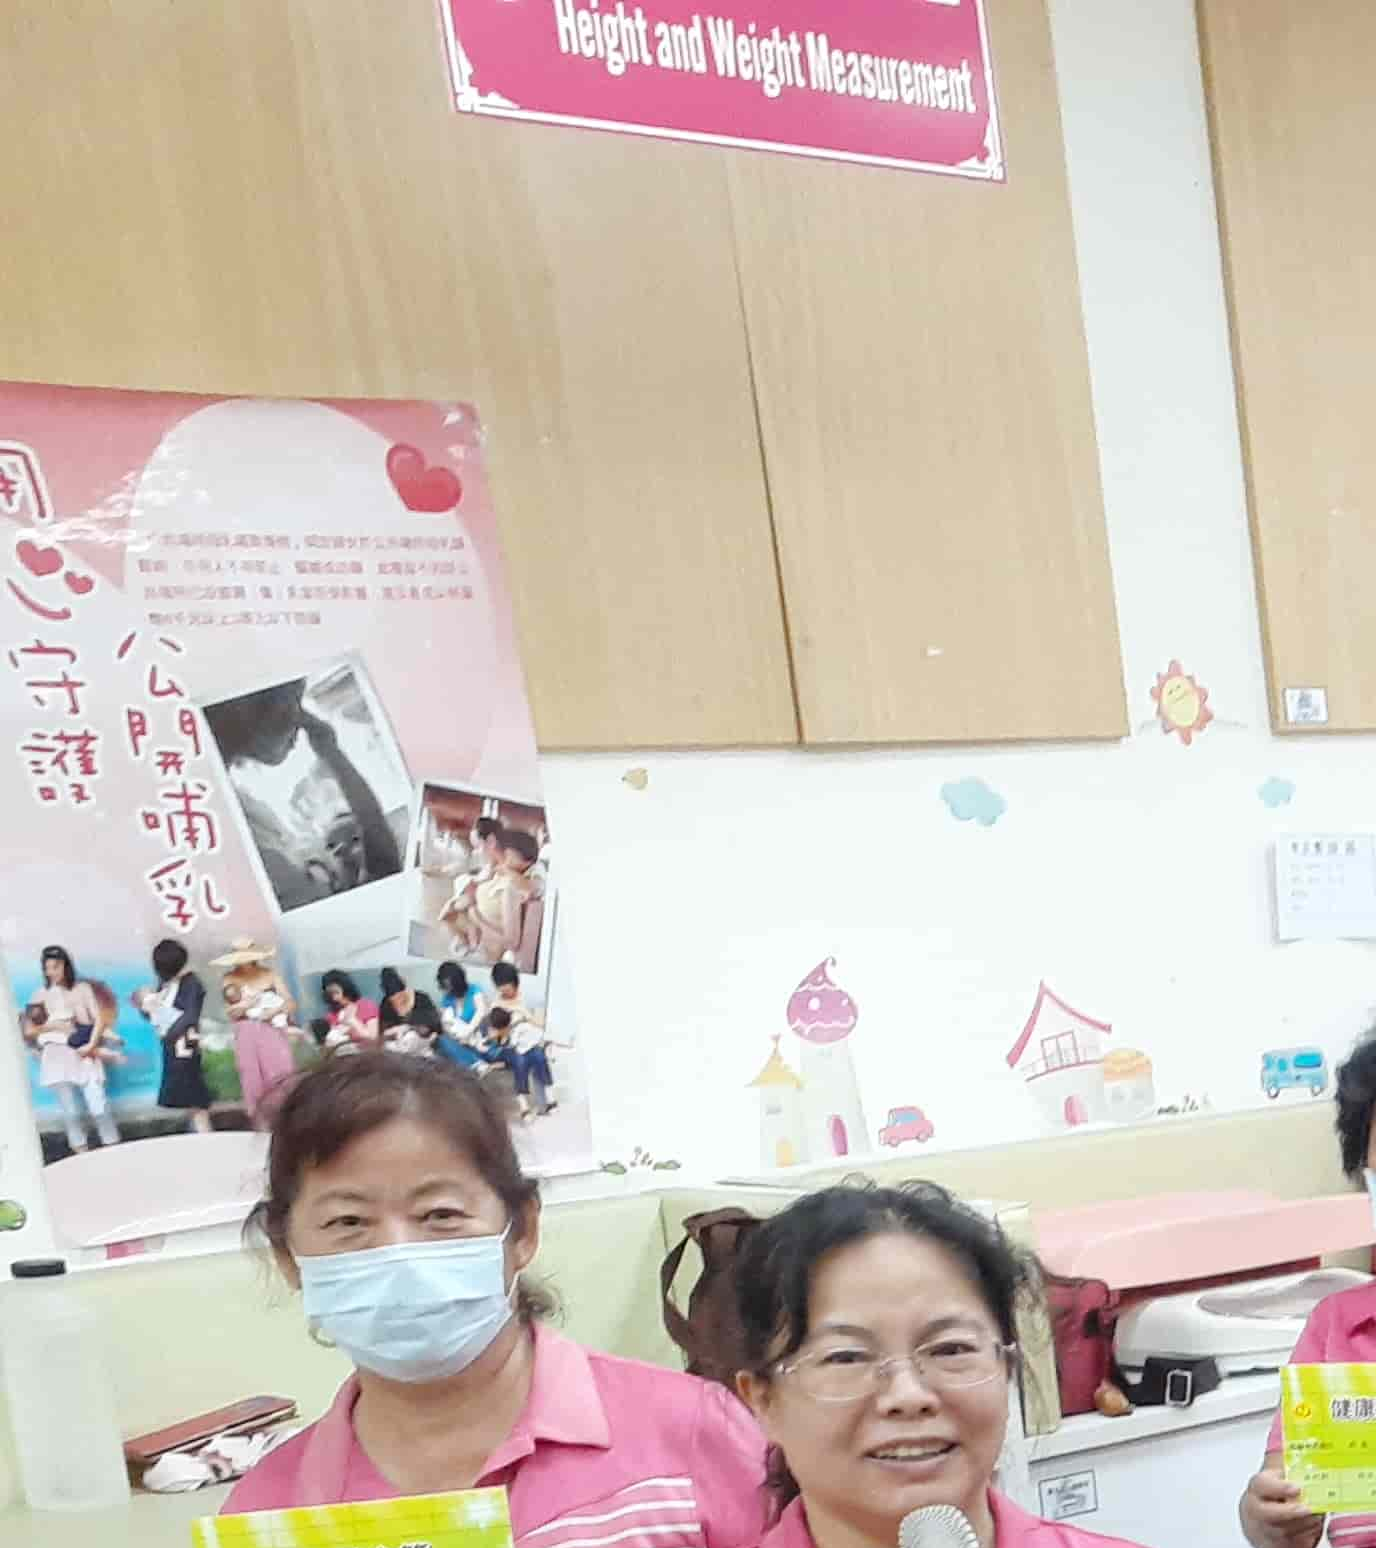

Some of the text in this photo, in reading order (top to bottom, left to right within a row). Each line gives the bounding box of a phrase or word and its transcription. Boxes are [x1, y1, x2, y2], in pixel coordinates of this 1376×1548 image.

[554, 0, 976, 112] Height and Weight Measurement
[117, 631, 227, 927] 公開哺乳
